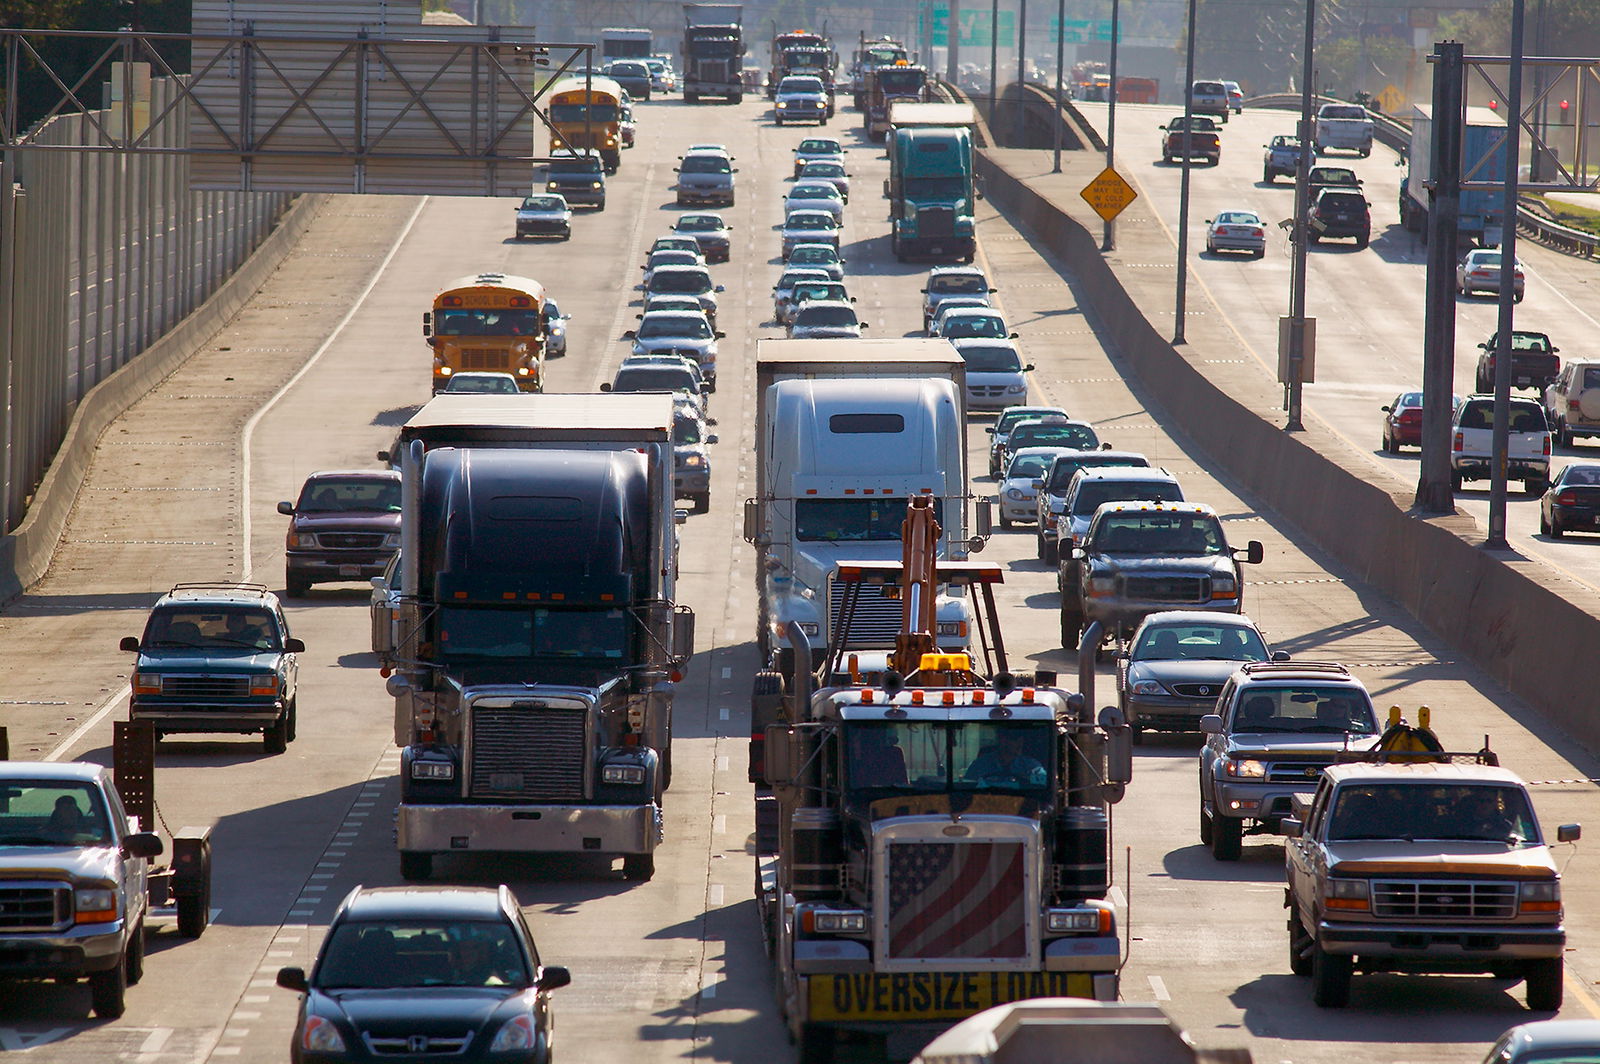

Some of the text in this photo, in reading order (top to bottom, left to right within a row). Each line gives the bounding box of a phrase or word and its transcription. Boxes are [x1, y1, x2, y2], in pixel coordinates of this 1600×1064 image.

[464, 295, 508, 306] SCHOOL BUS
[834, 972, 1068, 1012] OVERSIZE LOAD
